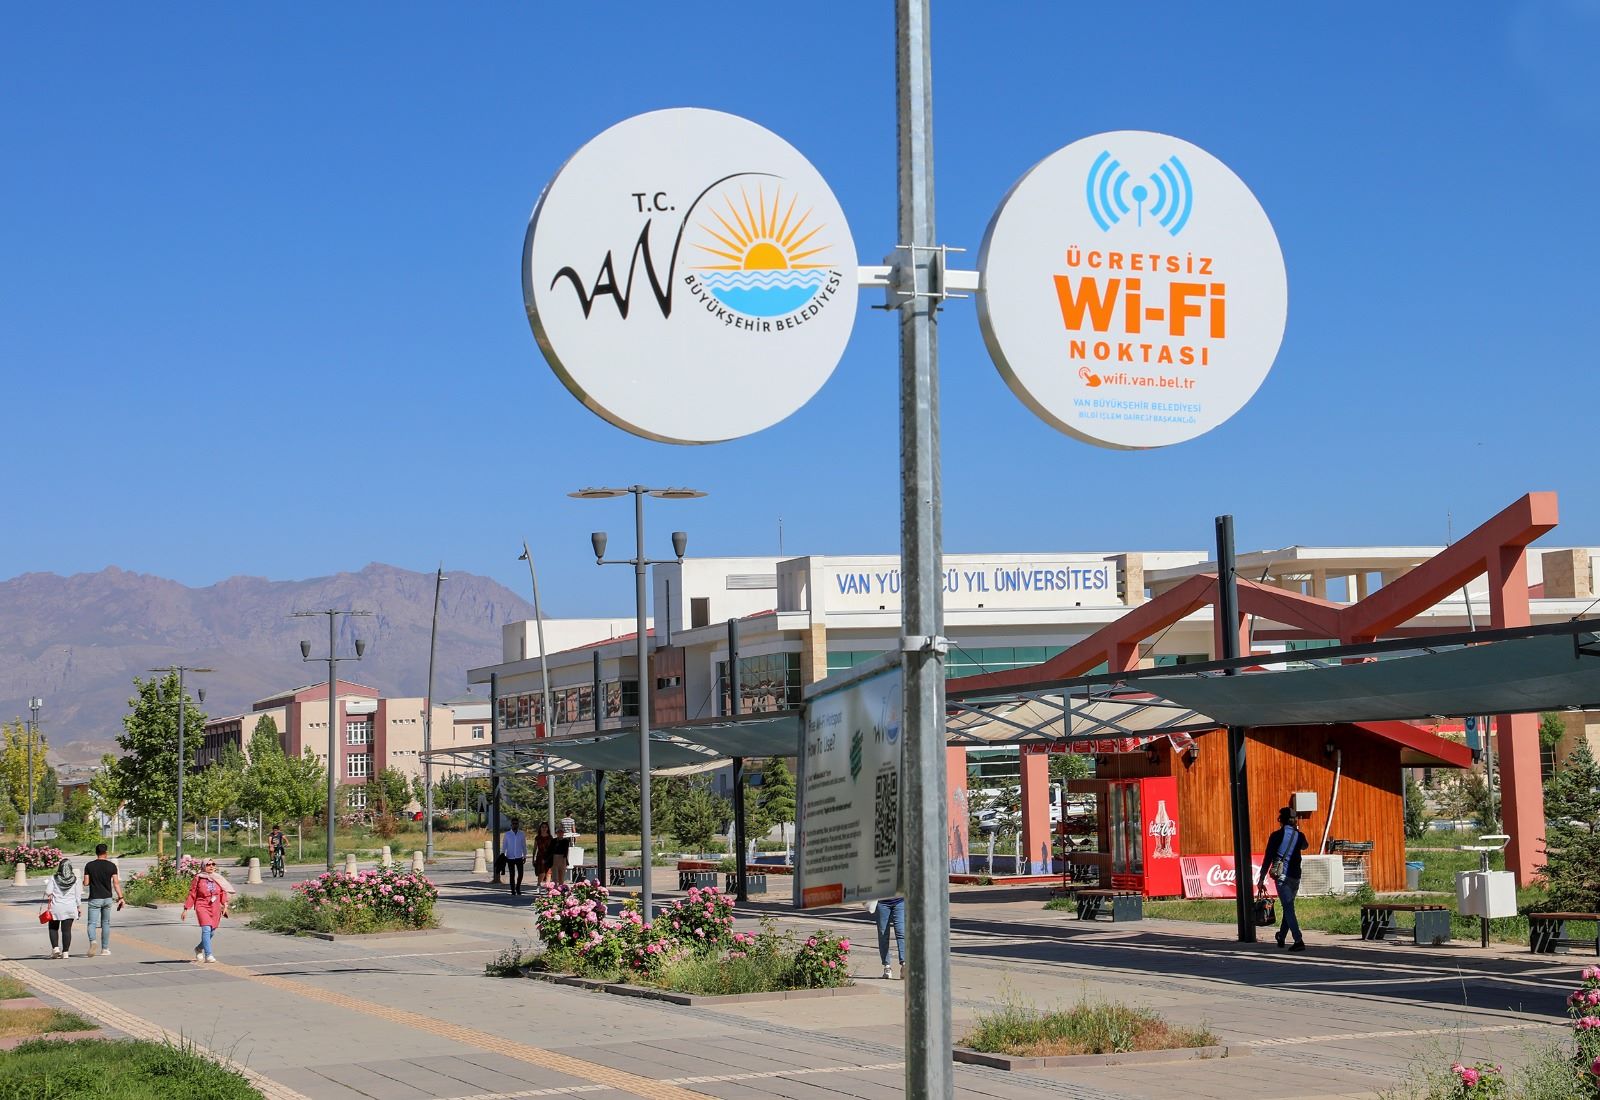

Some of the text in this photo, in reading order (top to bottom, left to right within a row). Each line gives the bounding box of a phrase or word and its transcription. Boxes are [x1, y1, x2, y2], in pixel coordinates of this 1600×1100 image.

[631, 191, 675, 213] T.C.
[1066, 245, 1214, 275] ÜCRETSİZ
[684, 269, 843, 332] BÜYÜKŞEHİR BELEDİYESİ
[1053, 275, 1226, 339] Wi-Fi
[1069, 340, 1209, 366] NOKTASI
[1103, 372, 1196, 389] wifi.van.bel.tr
[1073, 398, 1202, 413] VAN BÜYÜKŞEHİR BELEDİYESİ
[836, 573, 871, 594] VAN
[964, 571, 990, 593] YIL
[994, 566, 1109, 592] ÜNİVERSİTESİ
